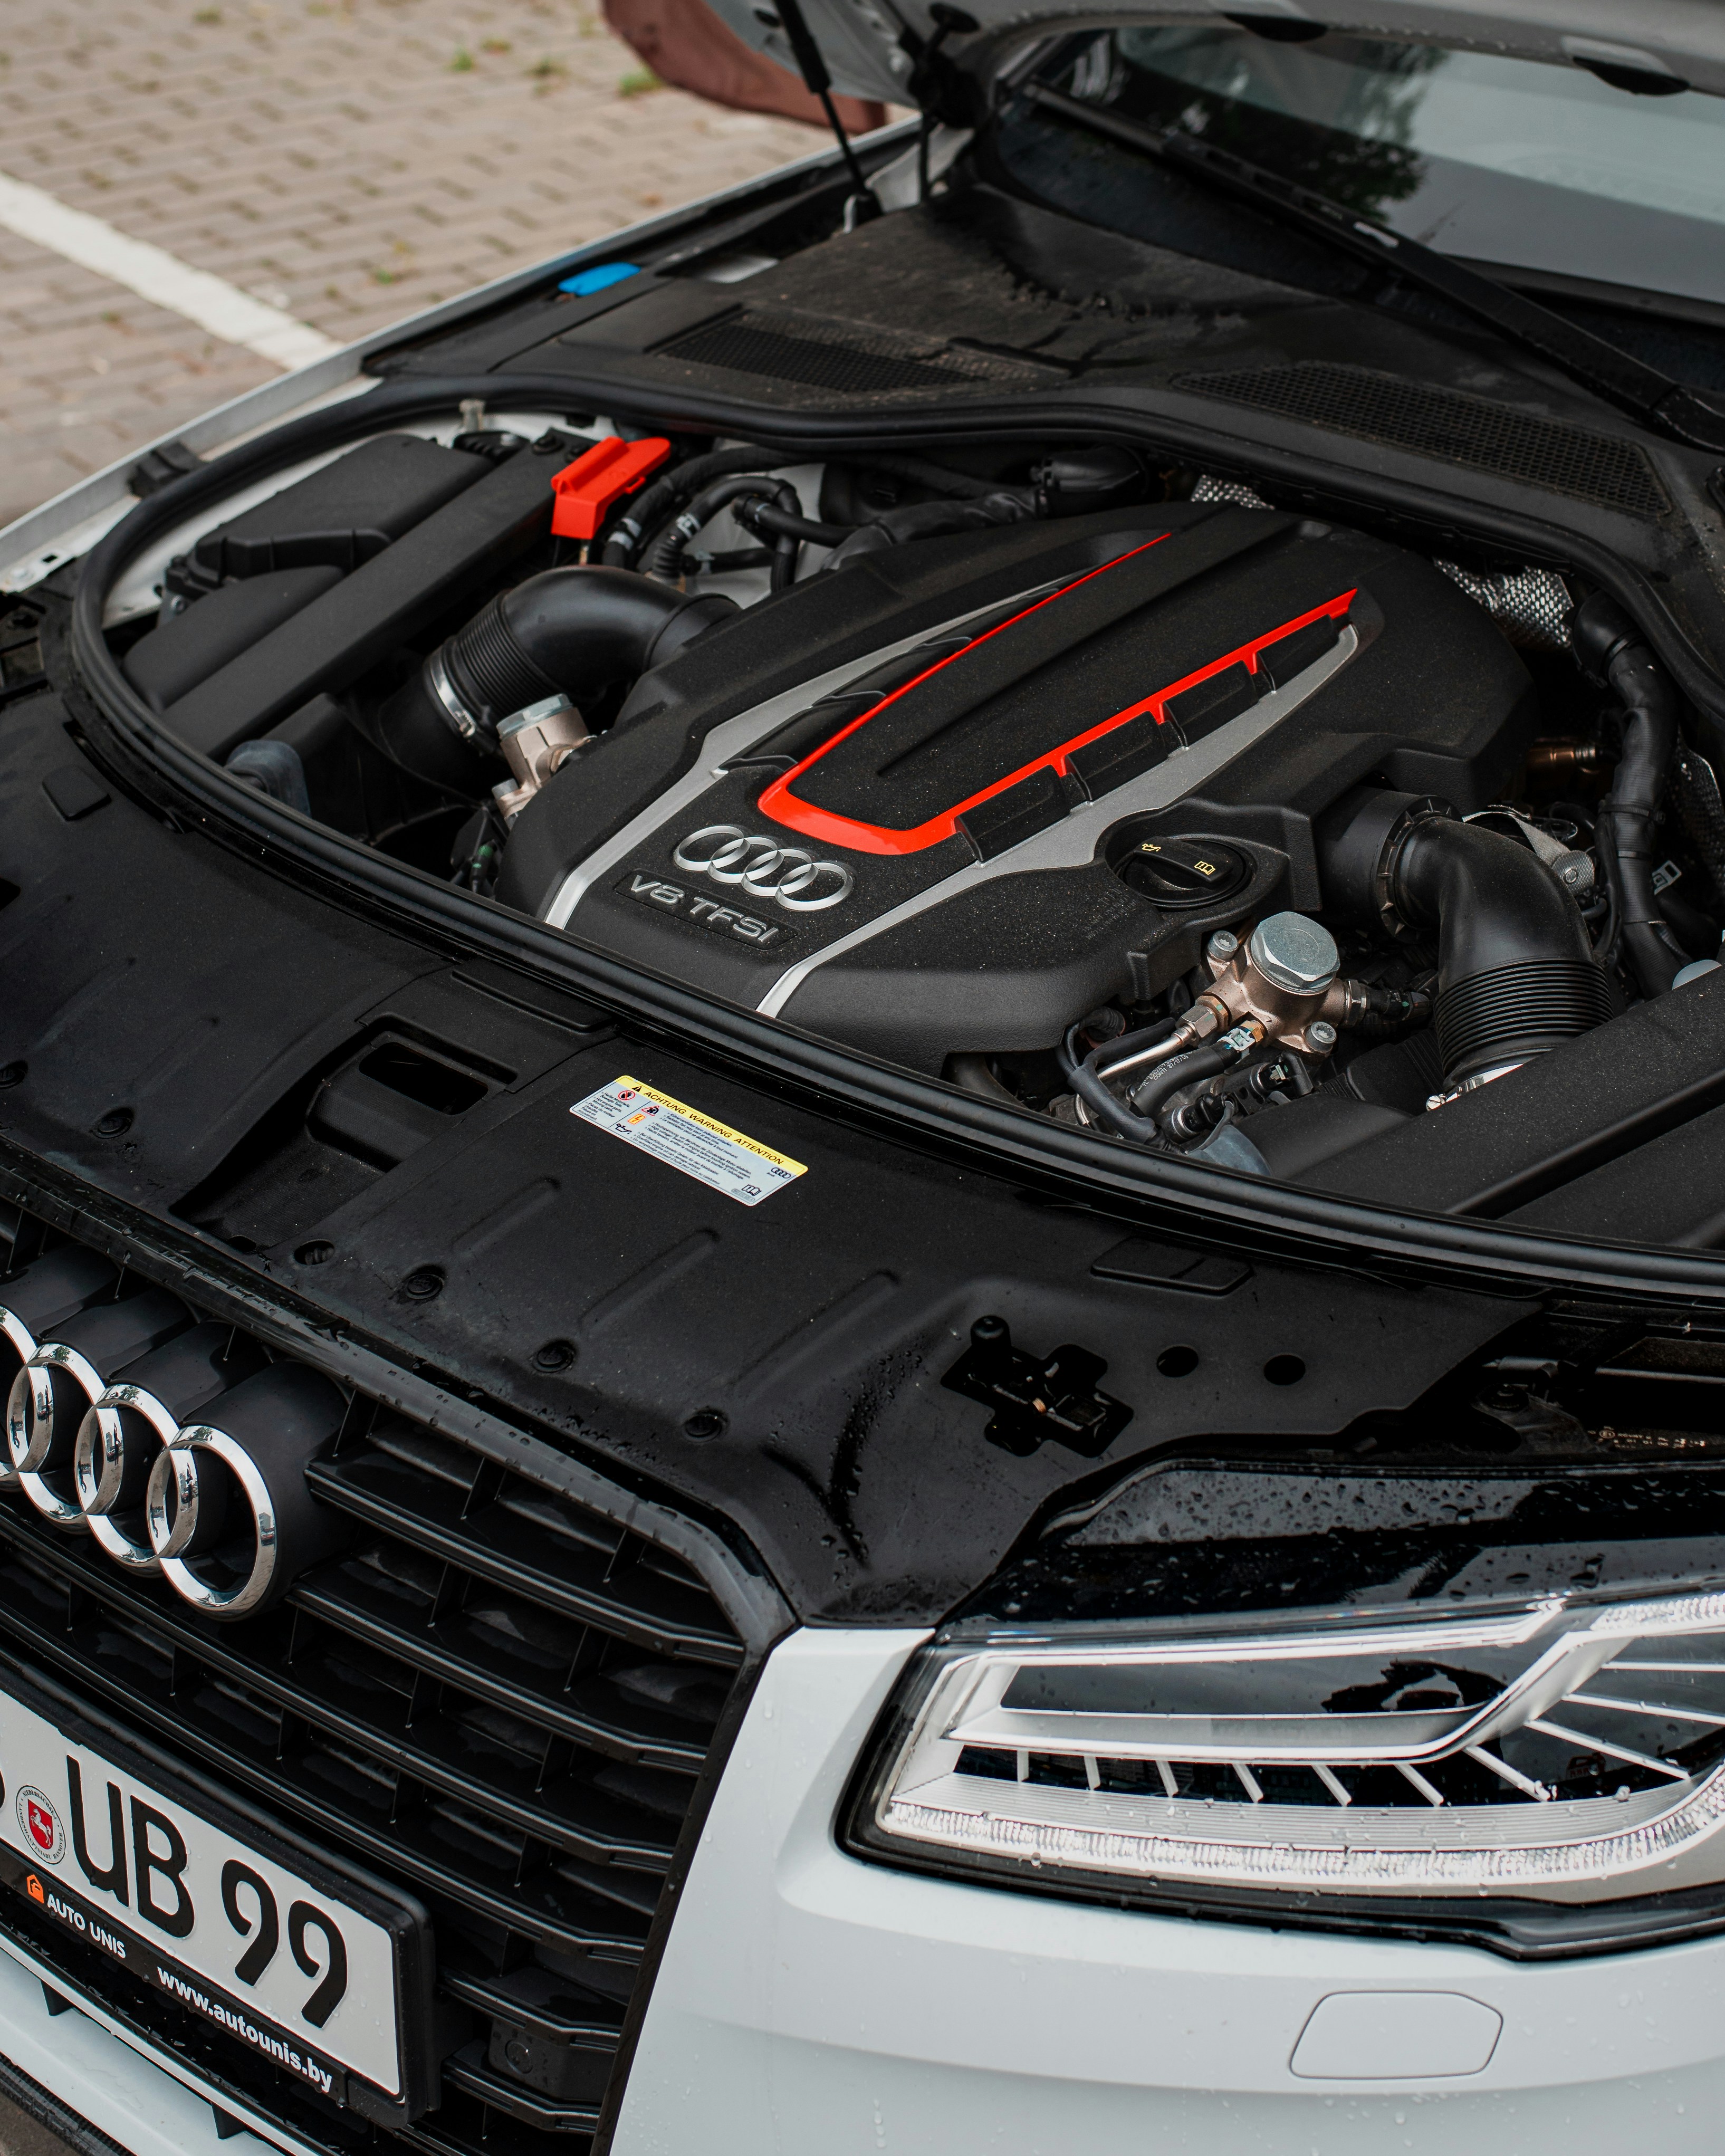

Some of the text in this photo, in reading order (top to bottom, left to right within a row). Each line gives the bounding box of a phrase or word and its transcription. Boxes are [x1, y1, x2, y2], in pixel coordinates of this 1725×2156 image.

[630, 874, 779, 943] V8 TFSI
[1153, 1068, 1167, 1080] CONTI
[642, 1090, 785, 1165] ACHTUNG WARNING ATTENTION
[47, 1893, 127, 1959] AUTO UNIS
[66, 1754, 348, 2029] UB 99
[157, 1966, 332, 2094] www.autounis.by
